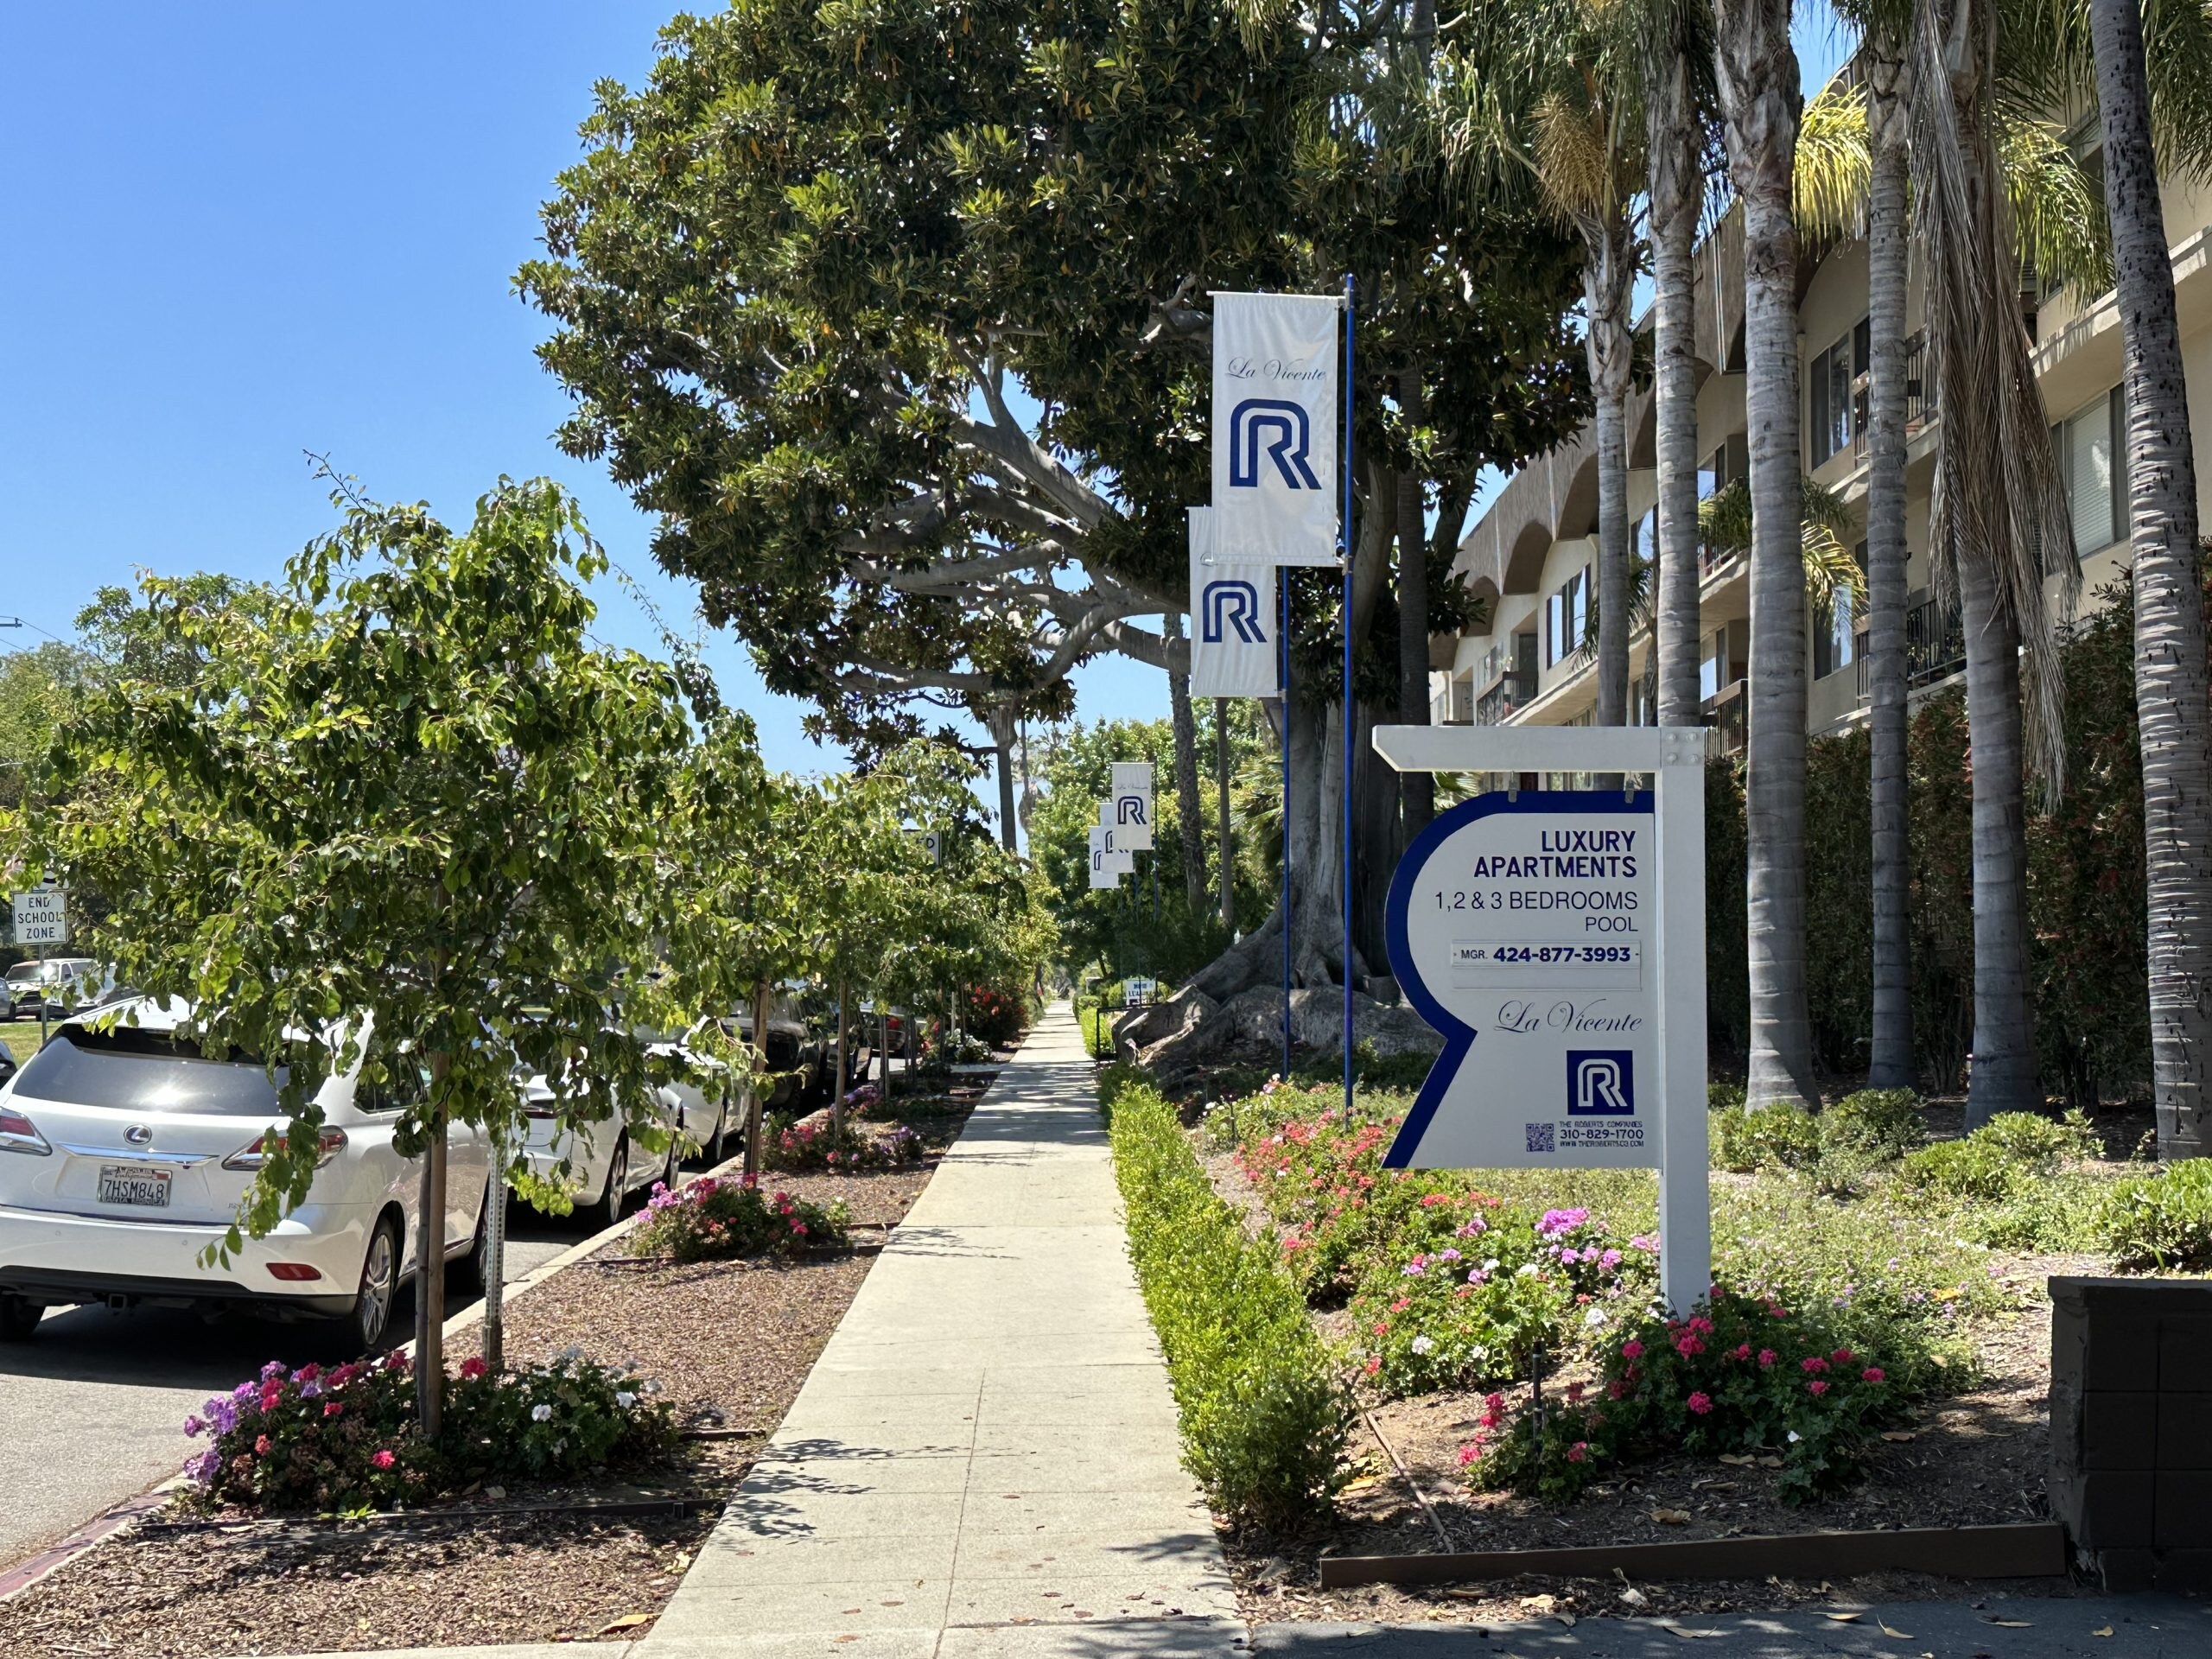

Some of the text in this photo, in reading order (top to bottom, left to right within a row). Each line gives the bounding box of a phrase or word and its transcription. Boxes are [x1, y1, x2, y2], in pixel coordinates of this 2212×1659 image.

[1225, 357, 1327, 381] La Vicente
[1230, 398, 1322, 490] R
[1203, 581, 1267, 643] R
[1118, 796, 1147, 825] R
[1541, 830, 1637, 853] LUXURY
[1473, 856, 1637, 878] APARTMENTS
[29, 896, 51, 908] END
[1471, 891, 1485, 910] &
[1491, 891, 1503, 910] 3
[1510, 891, 1639, 911] BEDROOMS
[17, 911, 63, 924] SCHOOL
[1585, 916, 1639, 932] POOL
[26, 926, 56, 939] ZONE
[1460, 947, 1631, 963] MGR. 424-877-3993
[1493, 998, 1643, 1033] La Vicente
[1577, 1058, 1629, 1107] R
[1560, 1129, 1643, 1140] 310-829-1700
[104, 1179, 165, 1200] 7HSM848
